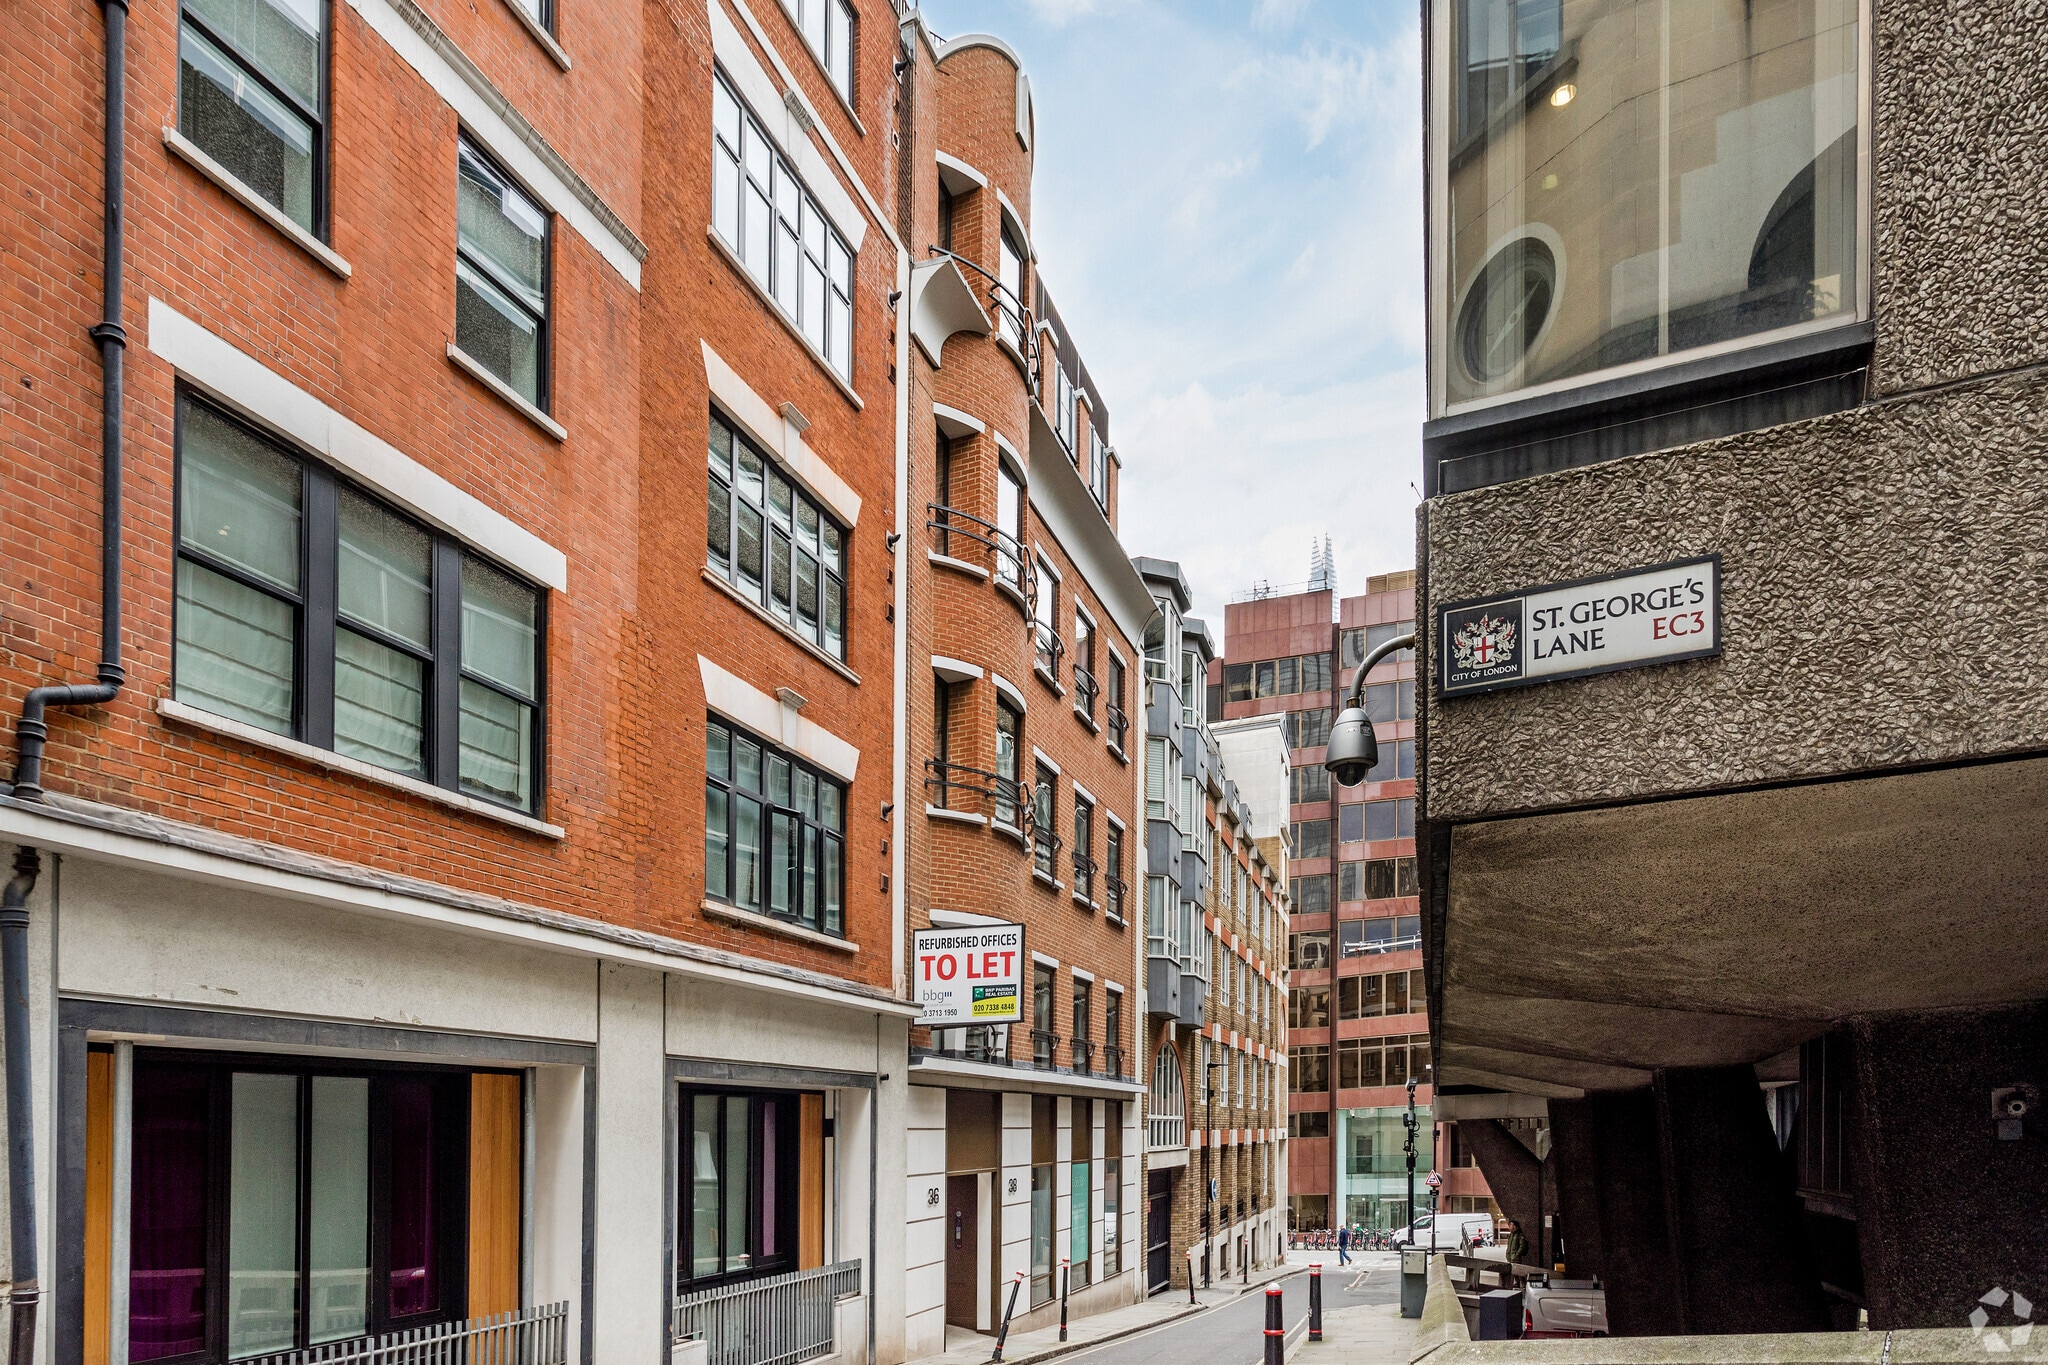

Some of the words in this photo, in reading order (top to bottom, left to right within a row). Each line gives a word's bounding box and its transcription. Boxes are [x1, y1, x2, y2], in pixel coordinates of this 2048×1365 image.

[1532, 606, 1565, 632] ST.
[1570, 578, 1705, 624] GEORGE'S
[1533, 627, 1606, 660] LANE
[1653, 611, 1706, 641] EC3
[1451, 672, 1469, 681] CITY
[1470, 670, 1482, 679] OF
[1483, 664, 1518, 676] LONDON
[919, 936, 978, 950] REFURBISHED
[981, 933, 1017, 947] OFFICES
[920, 953, 957, 981] TO
[966, 951, 1016, 979] LET
[922, 989, 944, 1003] bbg
[928, 1009, 942, 1017] 3713
[944, 1008, 958, 1016] 1950
[927, 1187, 939, 1205] 36
